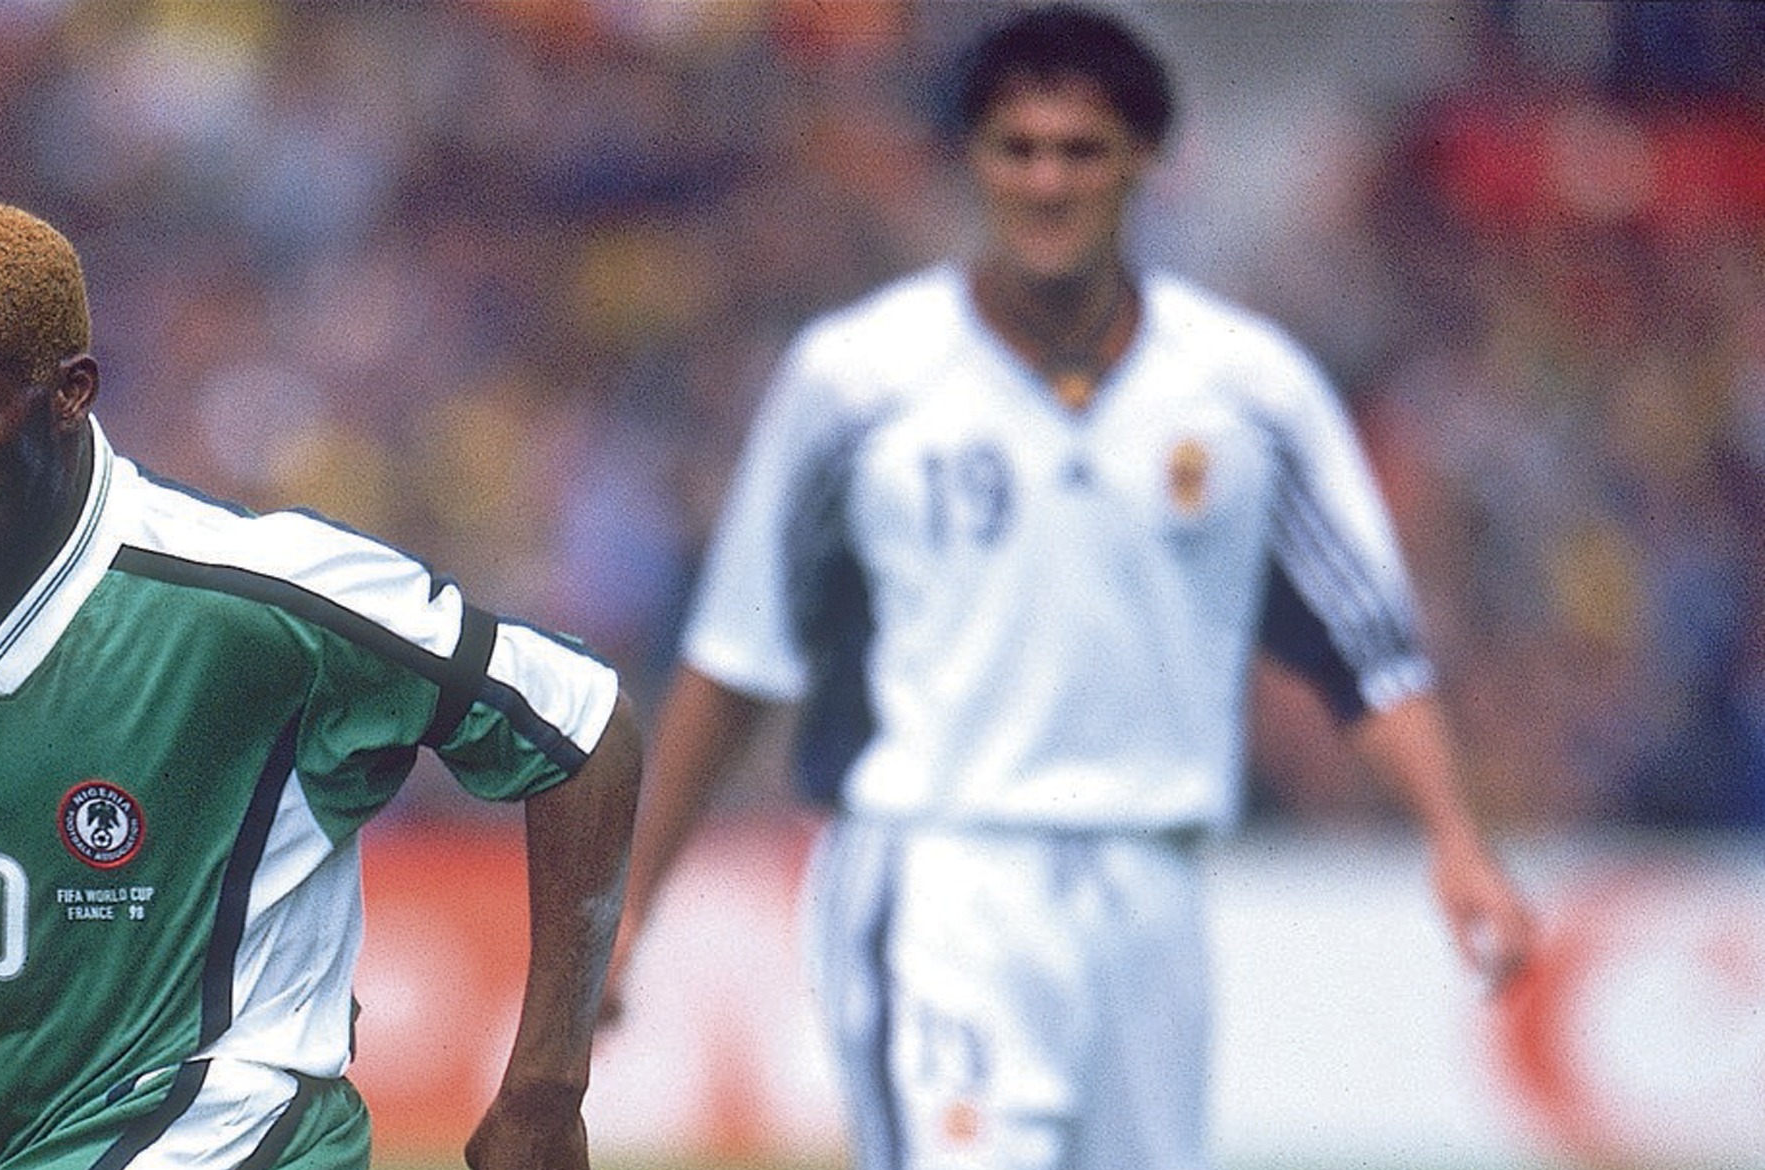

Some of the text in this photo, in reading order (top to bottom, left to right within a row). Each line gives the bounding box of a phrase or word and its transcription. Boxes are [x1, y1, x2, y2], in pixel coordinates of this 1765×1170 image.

[918, 440, 1018, 552] 19
[72, 787, 131, 812] NIGERIA
[56, 886, 154, 903] FIFA WORLD CUP
[67, 905, 145, 920] FRANCE 98
